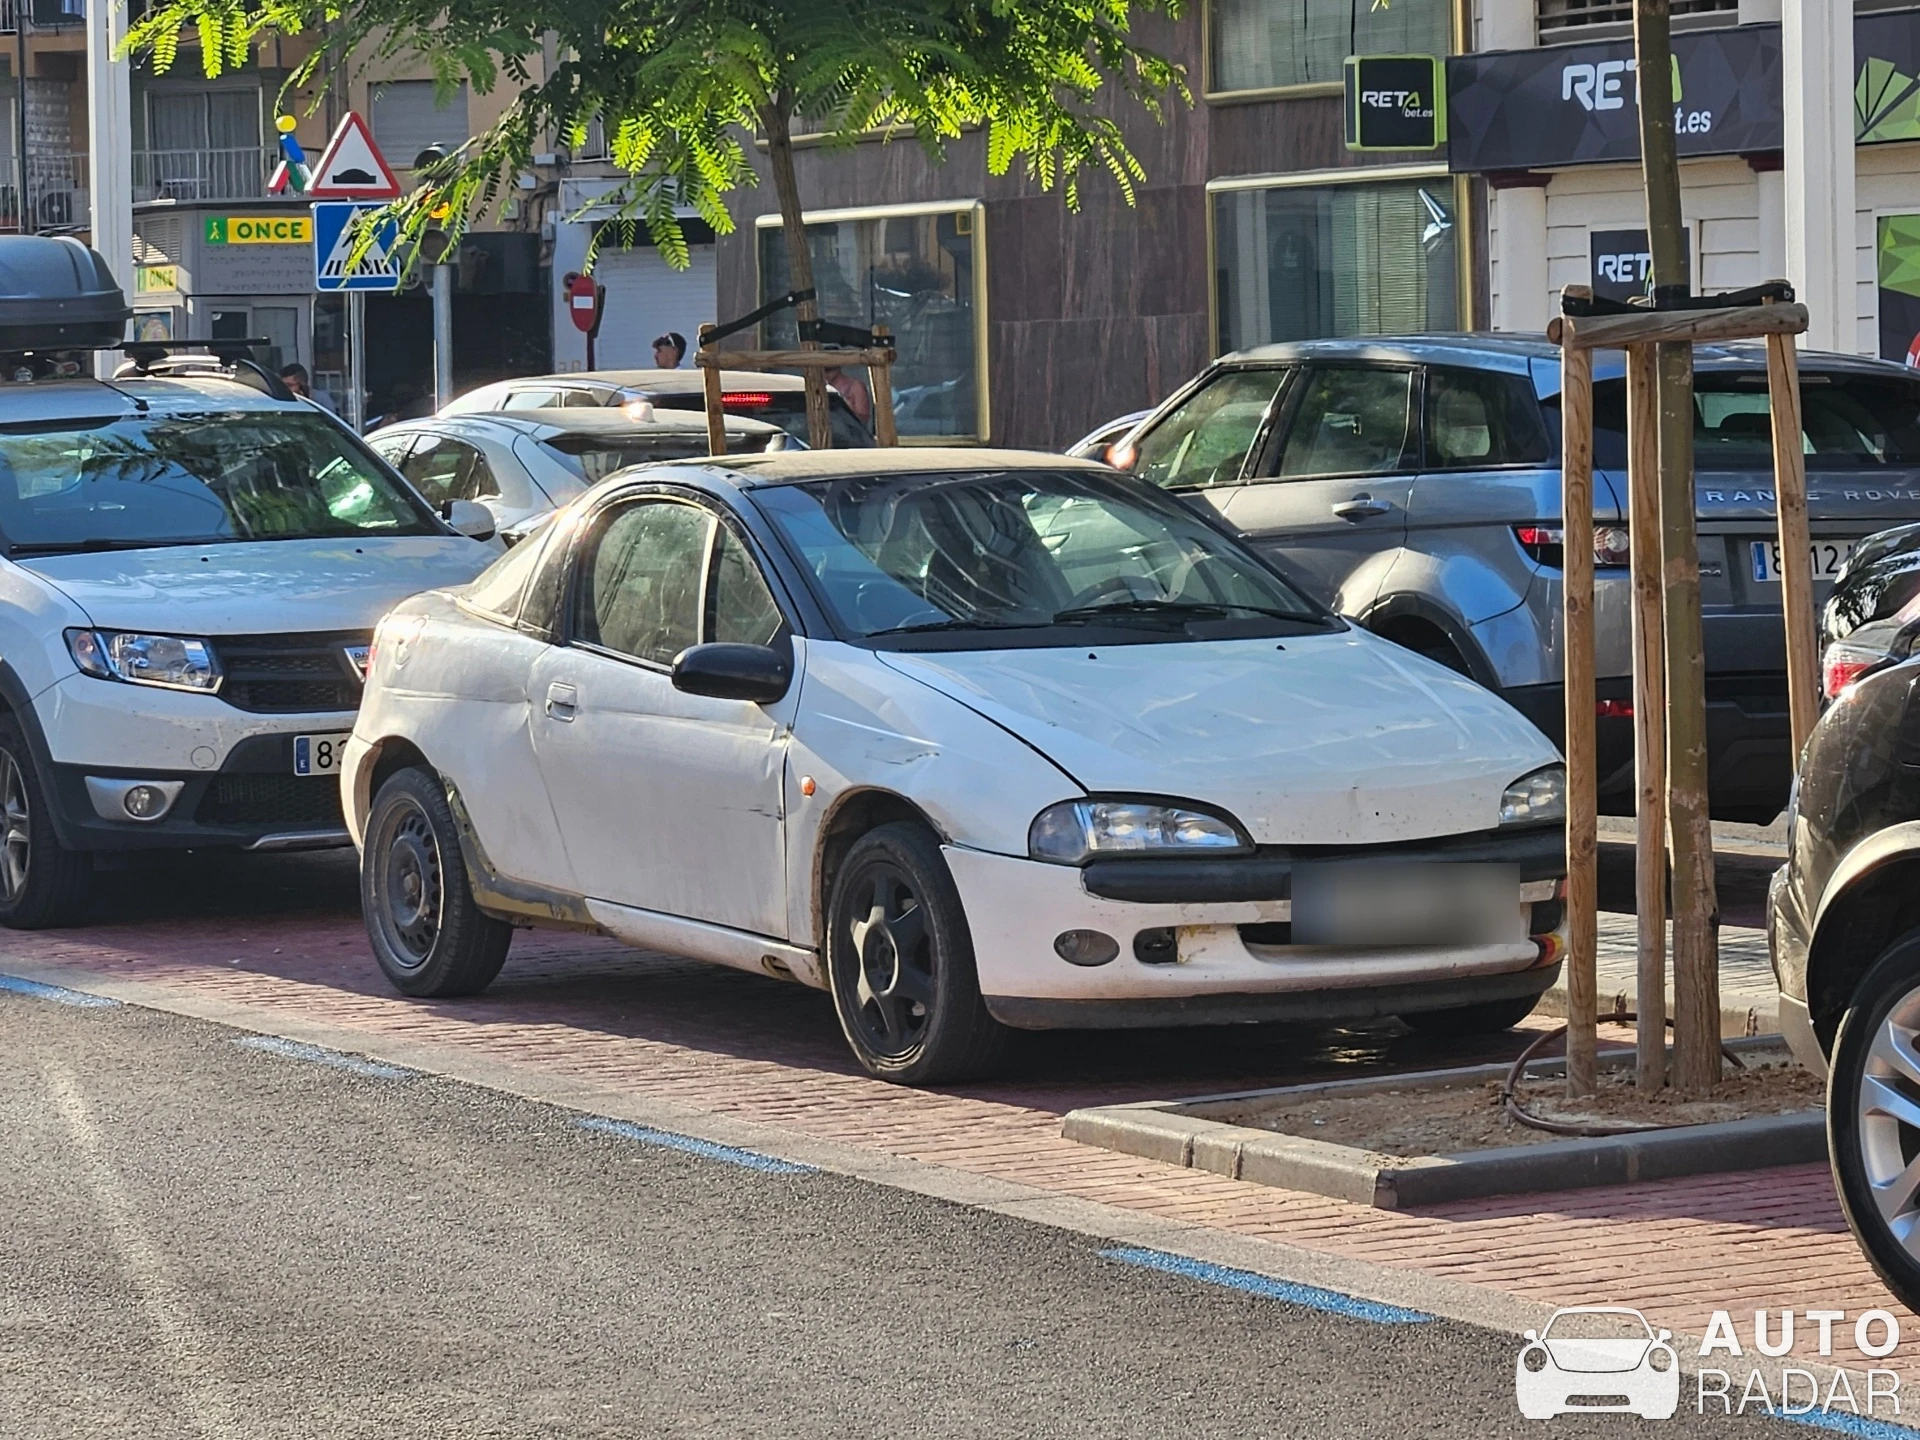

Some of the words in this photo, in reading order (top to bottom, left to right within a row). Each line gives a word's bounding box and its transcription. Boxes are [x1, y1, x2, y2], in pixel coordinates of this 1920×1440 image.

[1361, 91, 1420, 114] RETA
[1404, 108, 1433, 118] bet.es
[236, 221, 303, 239] ONCE
[150, 269, 174, 288] ONCE
[1598, 253, 1653, 295] RET
[1706, 490, 1820, 501] RANE
[1843, 490, 1920, 501] ROVE
[1772, 545, 1839, 574] 812
